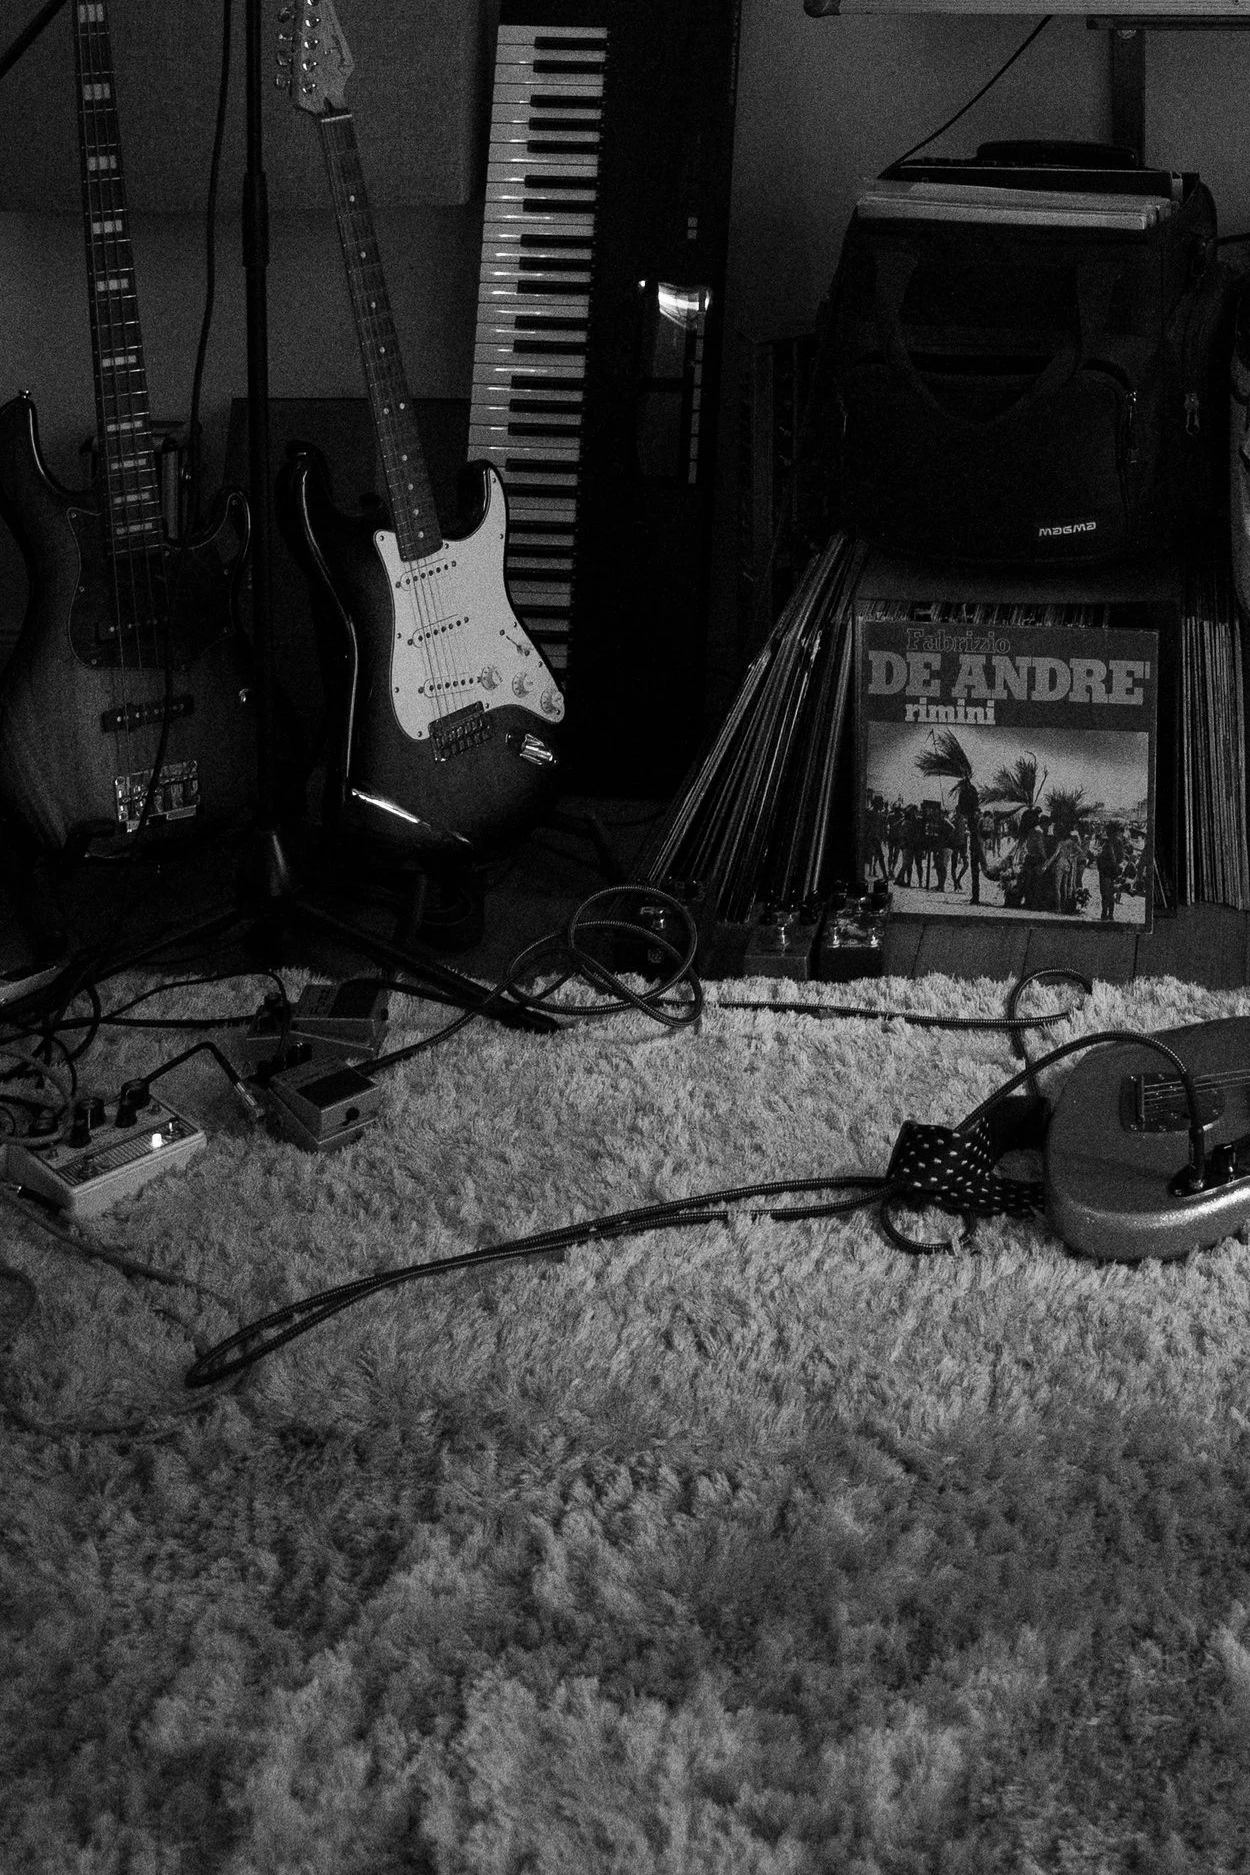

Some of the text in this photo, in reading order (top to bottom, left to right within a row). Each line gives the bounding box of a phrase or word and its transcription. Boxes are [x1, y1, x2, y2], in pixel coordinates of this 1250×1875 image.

[906, 627, 1011, 654] Fabrizio
[868, 650, 1150, 706] DE ANDRE'
[904, 696, 996, 725] rimini
